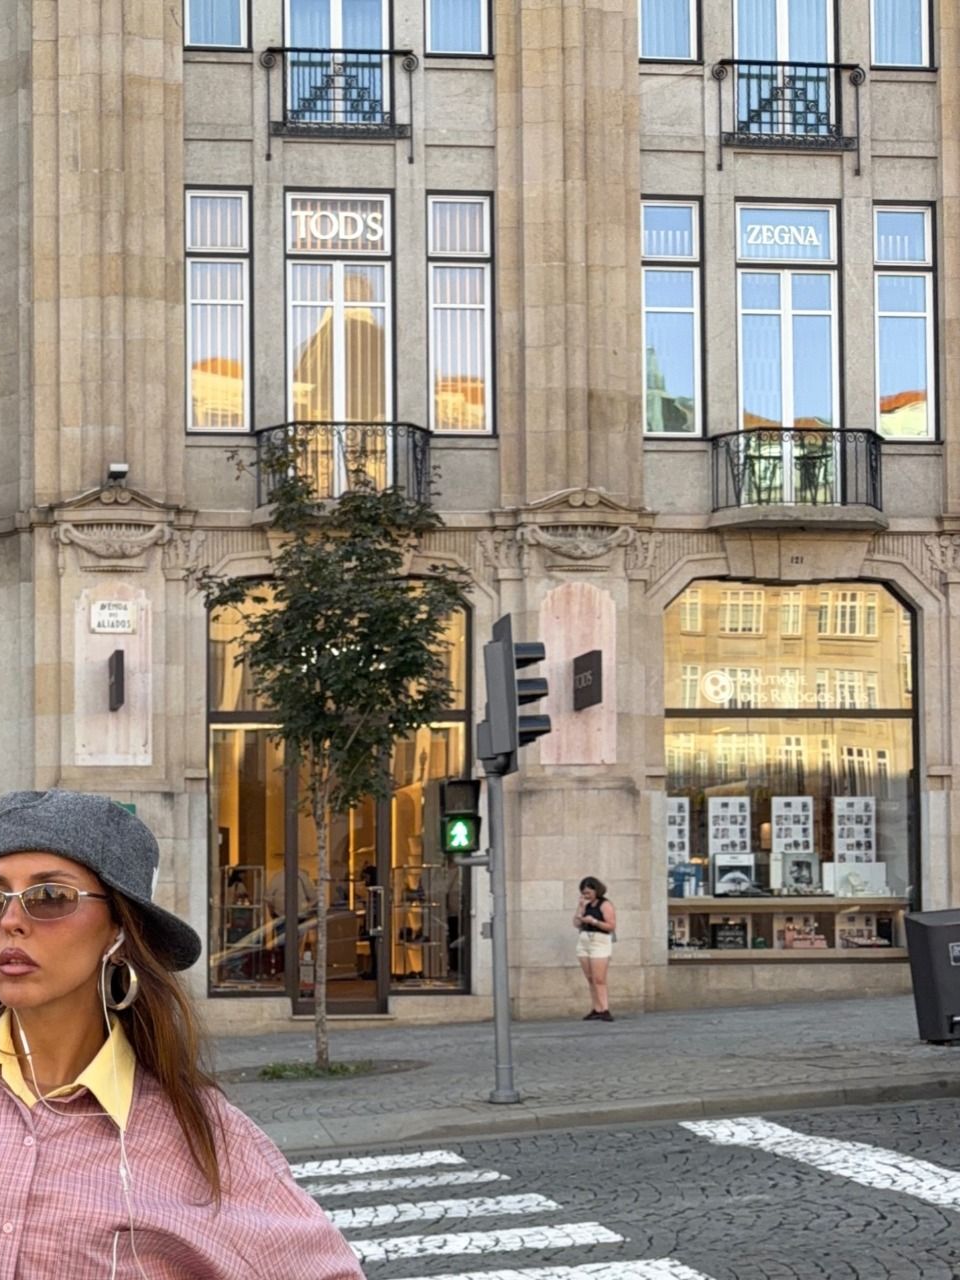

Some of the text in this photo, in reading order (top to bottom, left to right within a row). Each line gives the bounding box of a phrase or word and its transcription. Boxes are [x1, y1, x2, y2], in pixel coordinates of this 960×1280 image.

[292, 210, 384, 241] TOD'S
[746, 224, 821, 246] ZEGNA
[97, 619, 131, 629] ALIADOS
